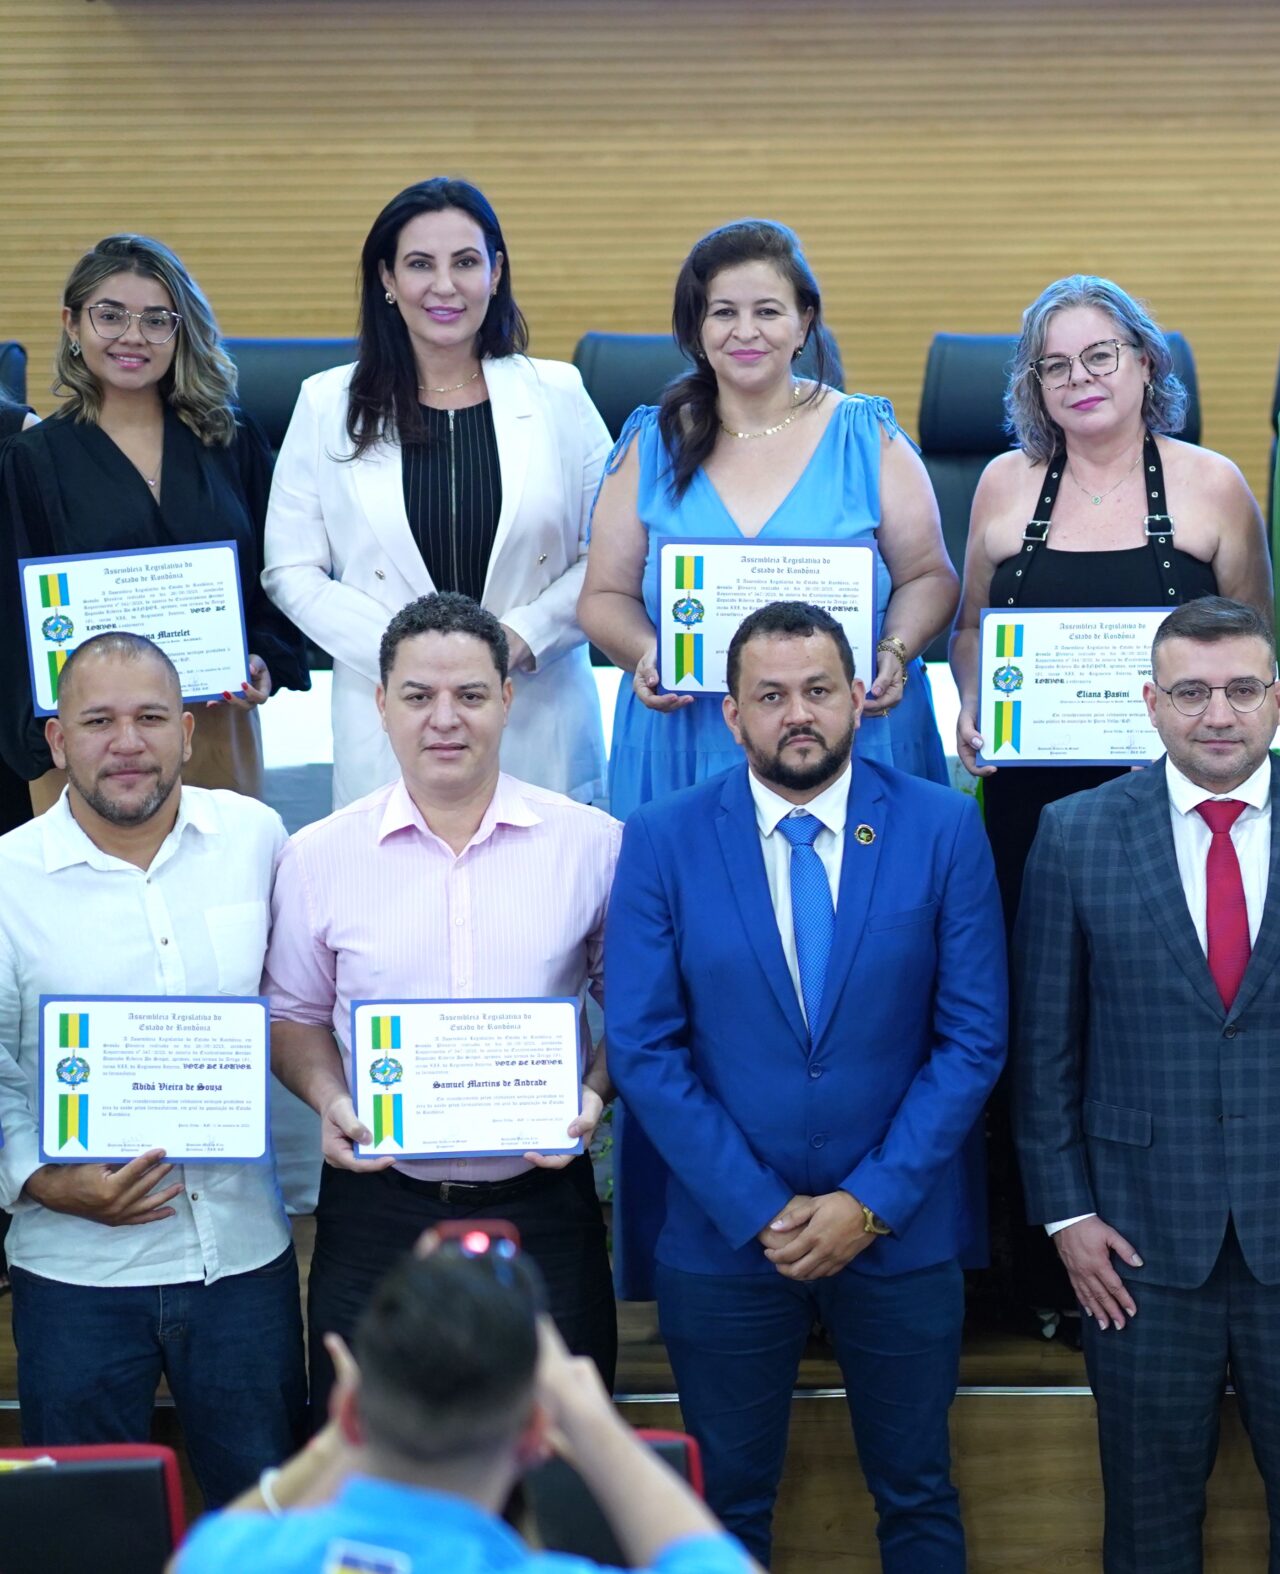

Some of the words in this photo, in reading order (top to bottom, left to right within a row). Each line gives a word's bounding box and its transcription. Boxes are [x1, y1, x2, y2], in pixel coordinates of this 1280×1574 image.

[782, 556, 820, 564] Legislativa
[104, 566, 142, 575] Assembleia
[145, 563, 183, 572] Legislativa
[115, 576, 138, 584] Estado
[157, 629, 190, 639] Martelet
[1076, 690, 1101, 698] Eliana
[1104, 690, 1130, 699] Pasini
[171, 1013, 211, 1021] Legislativa
[159, 1082, 183, 1091] Vieira
[197, 1083, 222, 1092] Souza
[433, 1081, 464, 1089] Samuel
[467, 1080, 500, 1088] Martins
